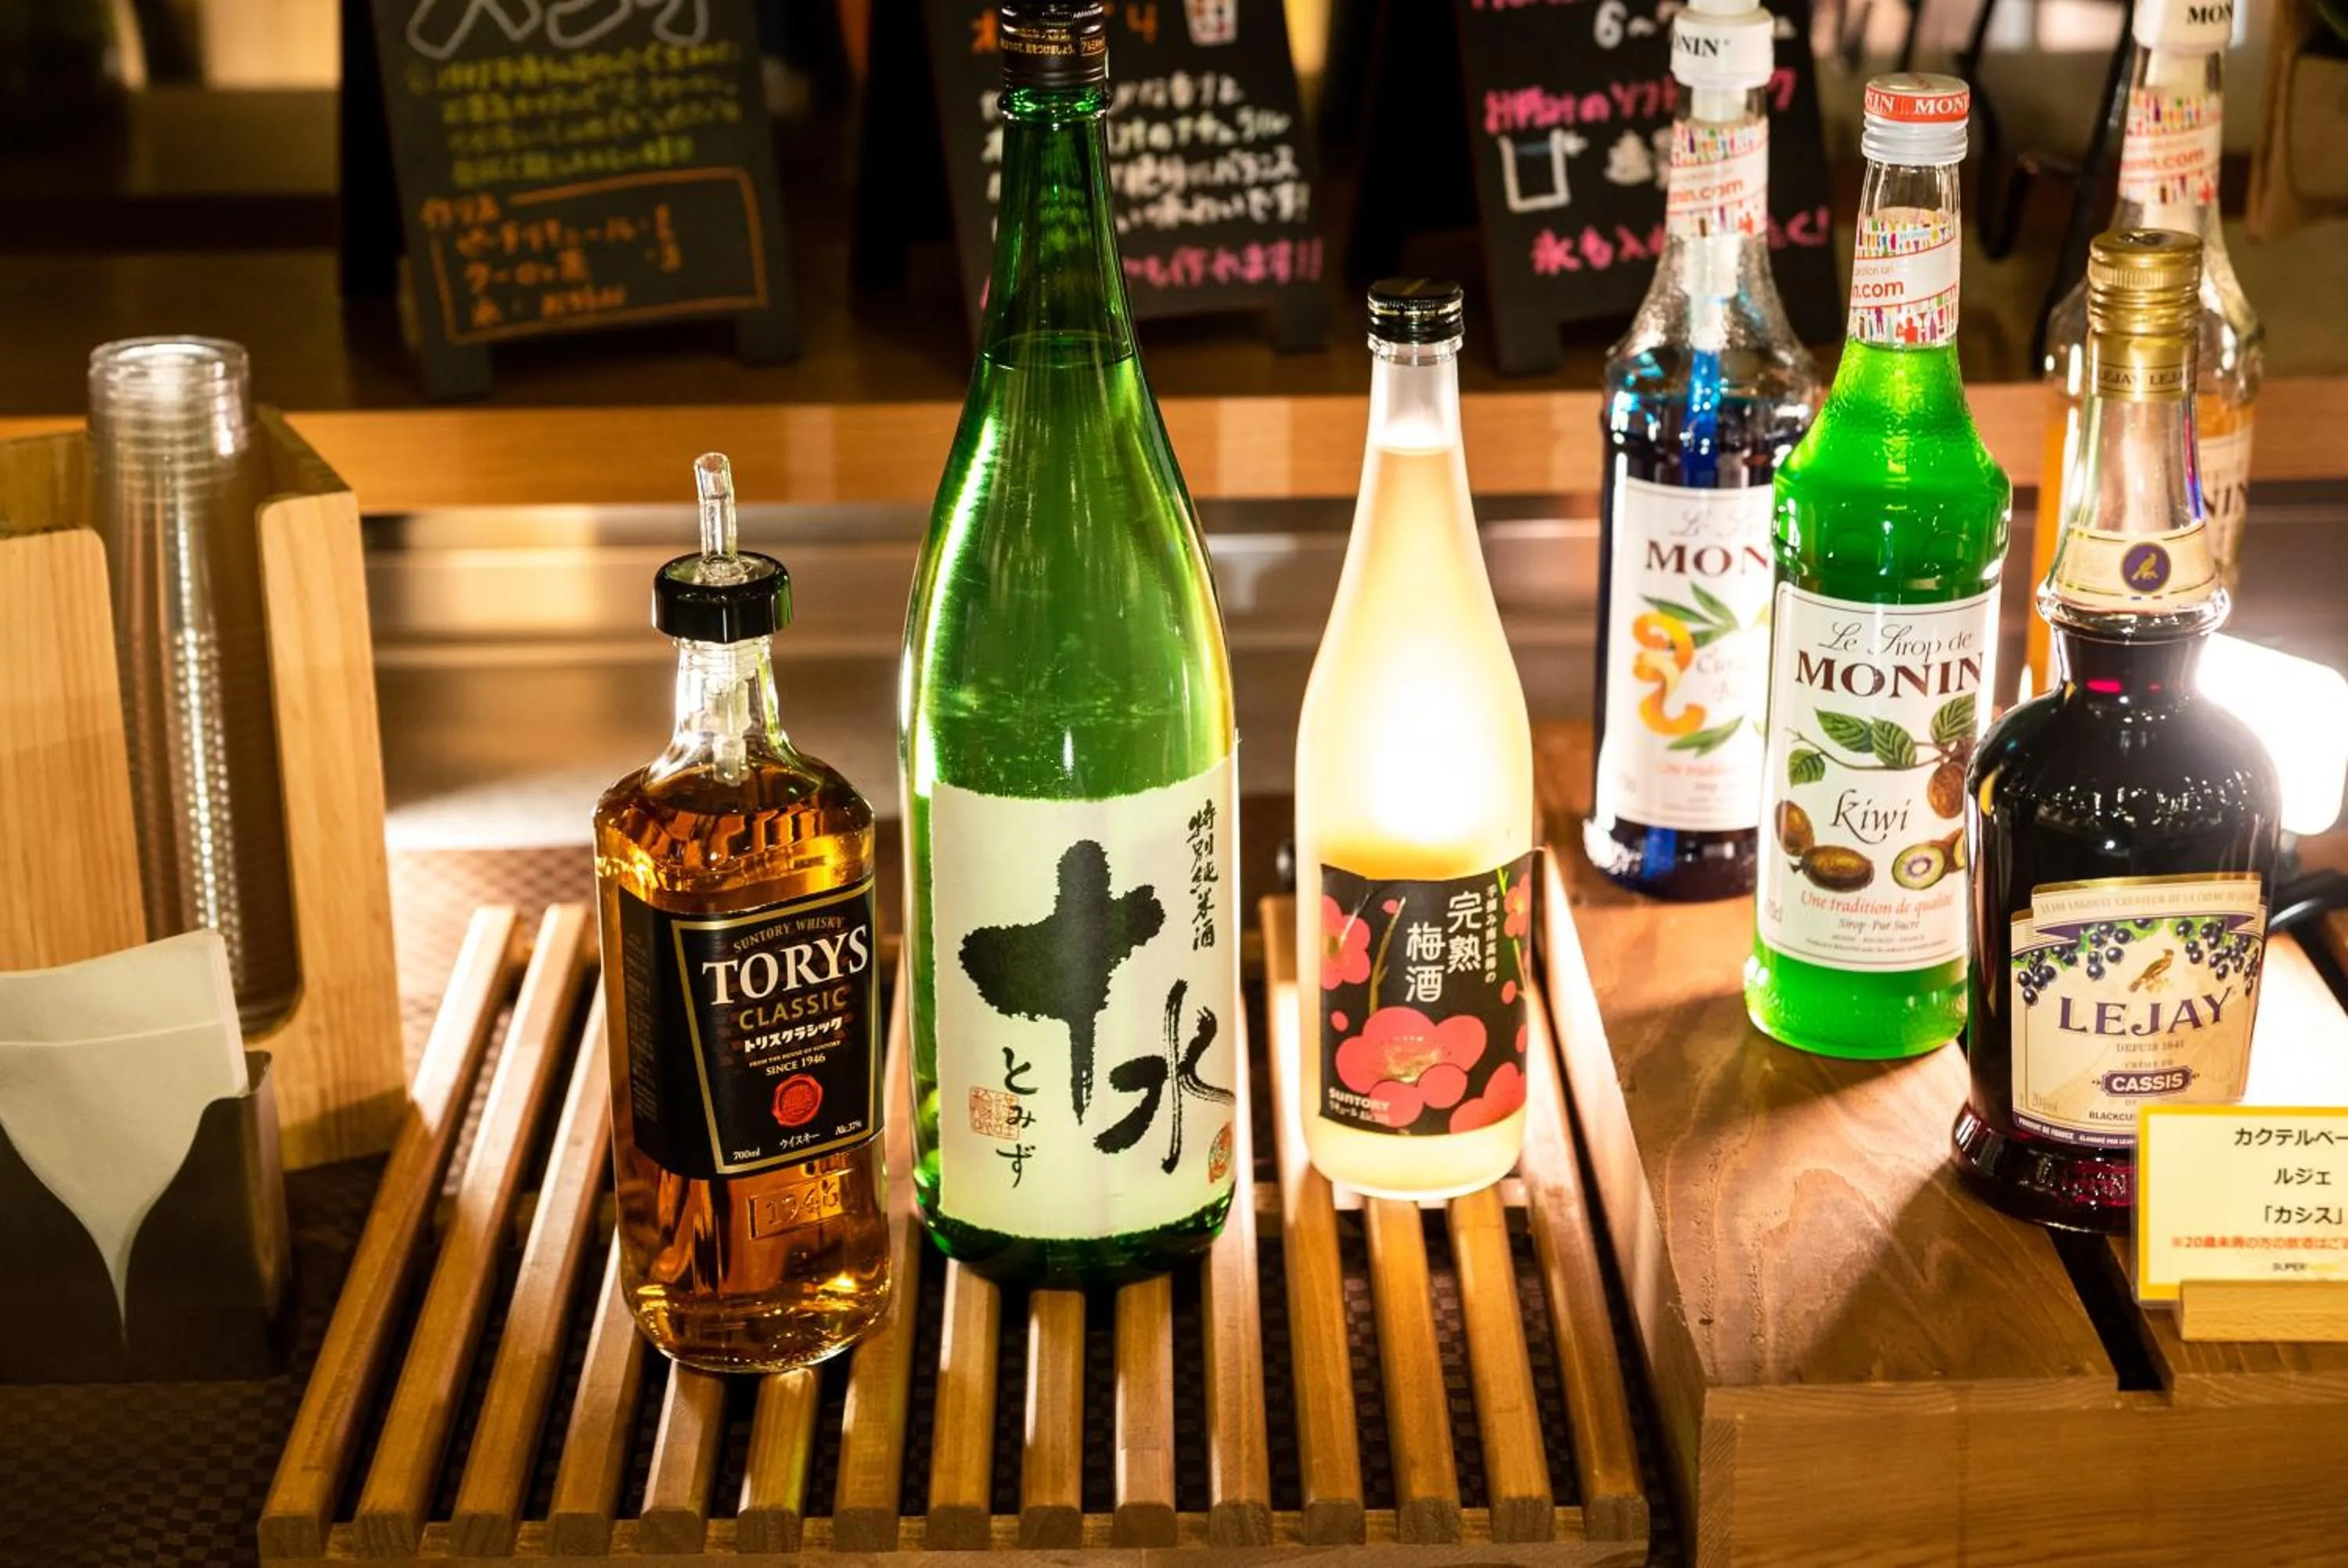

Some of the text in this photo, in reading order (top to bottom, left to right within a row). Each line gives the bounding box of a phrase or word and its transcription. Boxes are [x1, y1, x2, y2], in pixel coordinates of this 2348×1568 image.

[1817, 621, 1973, 662] Le Sirop de
[1795, 650, 1983, 699] MONIN
[1187, 799, 1219, 952] 特別純米酒
[1800, 890, 1828, 910] Une
[1831, 896, 1892, 915] tradition
[1896, 897, 1911, 914] de
[733, 916, 845, 954] SUNTORY WHISKY
[1446, 890, 1482, 974] 完熟
[702, 925, 868, 1005] TORYS
[1406, 922, 1446, 1002] 梅酒
[739, 986, 848, 1030] CLASSIC
[2058, 985, 2234, 1038] LEJAY
[744, 1016, 843, 1053] トリスクラシック
[765, 1053, 826, 1076] SINCE 1946
[2112, 1073, 2184, 1093] CASSIS
[996, 1046, 1038, 1189] とみず
[1328, 1087, 1390, 1111] SUNTORY
[733, 1146, 762, 1160] 700ml
[778, 1133, 821, 1149] ウイスキー
[2234, 1127, 2348, 1147] カクテルベー
[2273, 1167, 2332, 1186] ルジェ
[2263, 1205, 2343, 1226] 「カシス」
